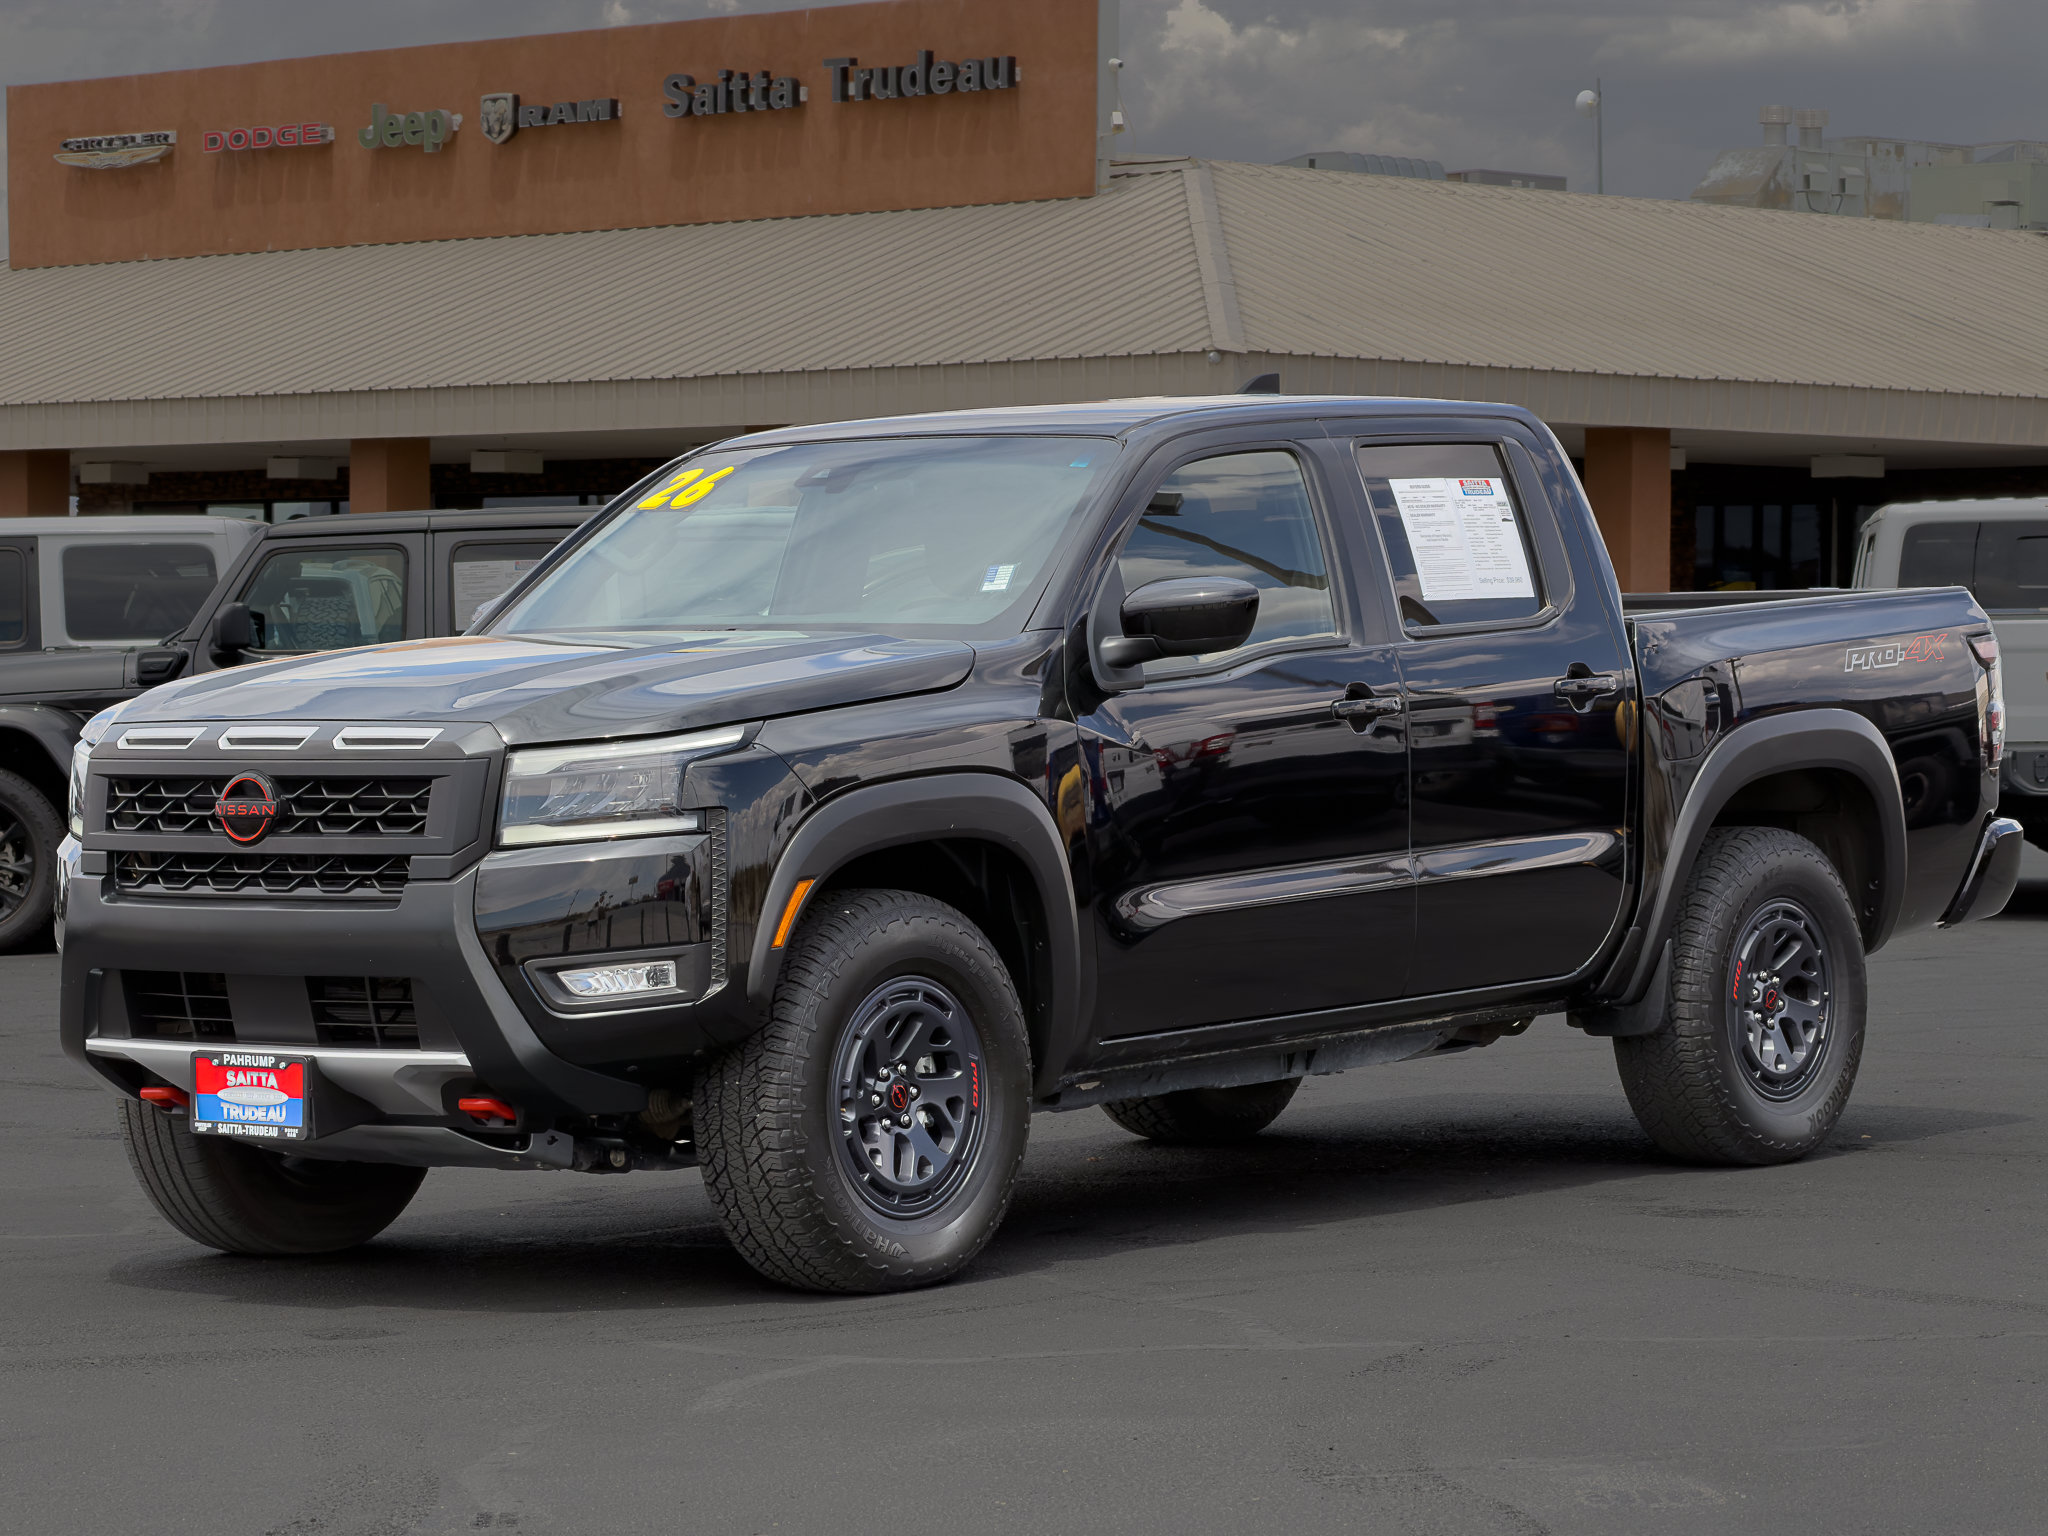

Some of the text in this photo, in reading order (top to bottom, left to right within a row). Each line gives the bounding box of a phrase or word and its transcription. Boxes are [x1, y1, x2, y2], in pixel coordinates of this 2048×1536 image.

[663, 49, 1017, 118] Saitta Trudeau
[519, 98, 618, 128] RAM
[203, 121, 327, 153] DODGE
[358, 103, 452, 153] Jeep
[60, 131, 171, 151] CHRYSLER
[637, 466, 734, 510] 26
[215, 804, 275, 815] NISSAN
[223, 1054, 275, 1068] PAHRUMP
[226, 1070, 279, 1089] SAITTA
[220, 1101, 287, 1123] TRUDEAU
[217, 1123, 278, 1137] SAITTA-TRUDEAU
